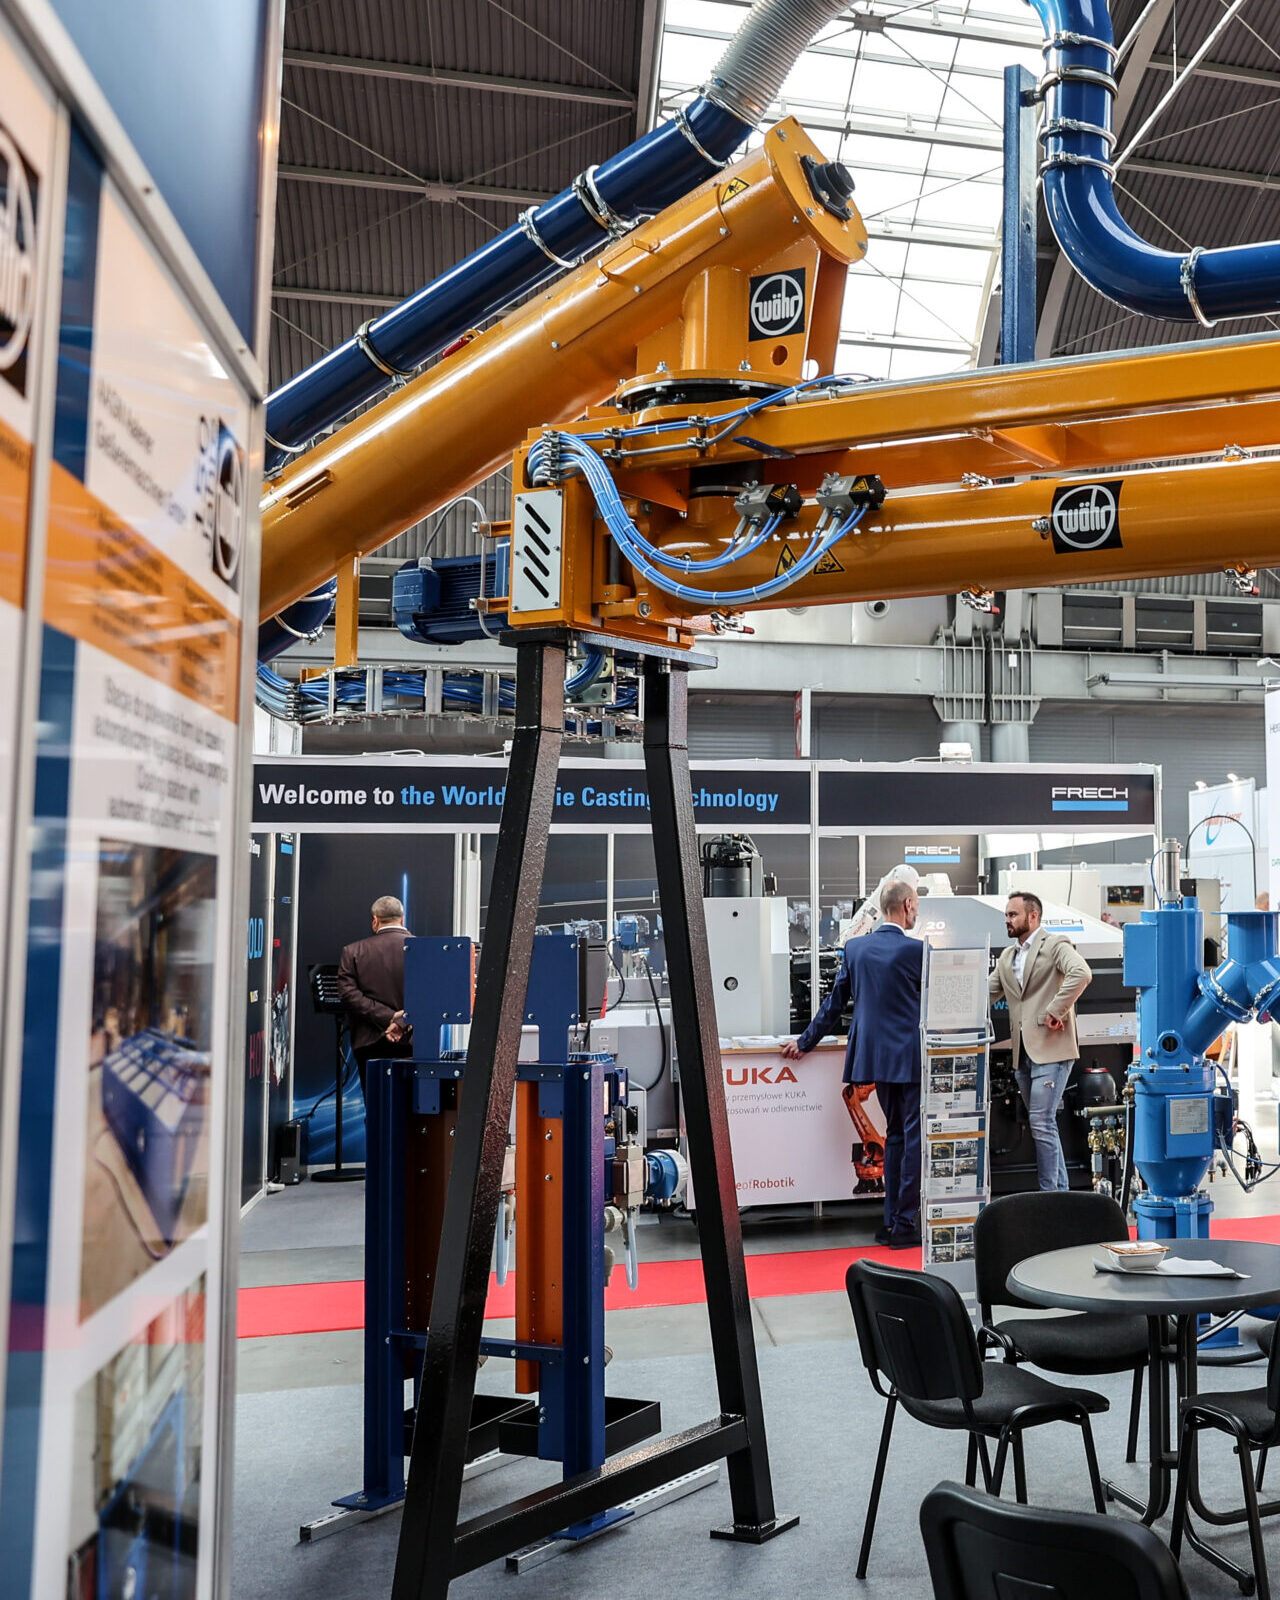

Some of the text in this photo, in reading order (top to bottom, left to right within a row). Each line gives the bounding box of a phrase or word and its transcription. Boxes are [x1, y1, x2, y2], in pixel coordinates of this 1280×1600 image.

[754, 278, 800, 323] wöhr
[1056, 488, 1112, 534] wöhr
[259, 783, 367, 805] Welcome
[373, 786, 395, 805] to
[400, 785, 435, 805] the
[441, 785, 505, 806] World
[556, 786, 575, 806] ie
[692, 788, 779, 812] chnology
[1052, 787, 1129, 799] FRECH
[904, 846, 961, 855] FRECH
[726, 1066, 799, 1086] UKA
[732, 1091, 783, 1103] przemysłowe
[785, 1090, 807, 1099] KUKA
[771, 1103, 823, 1113] odlewnictwie
[736, 1176, 795, 1191] eofRobotik
